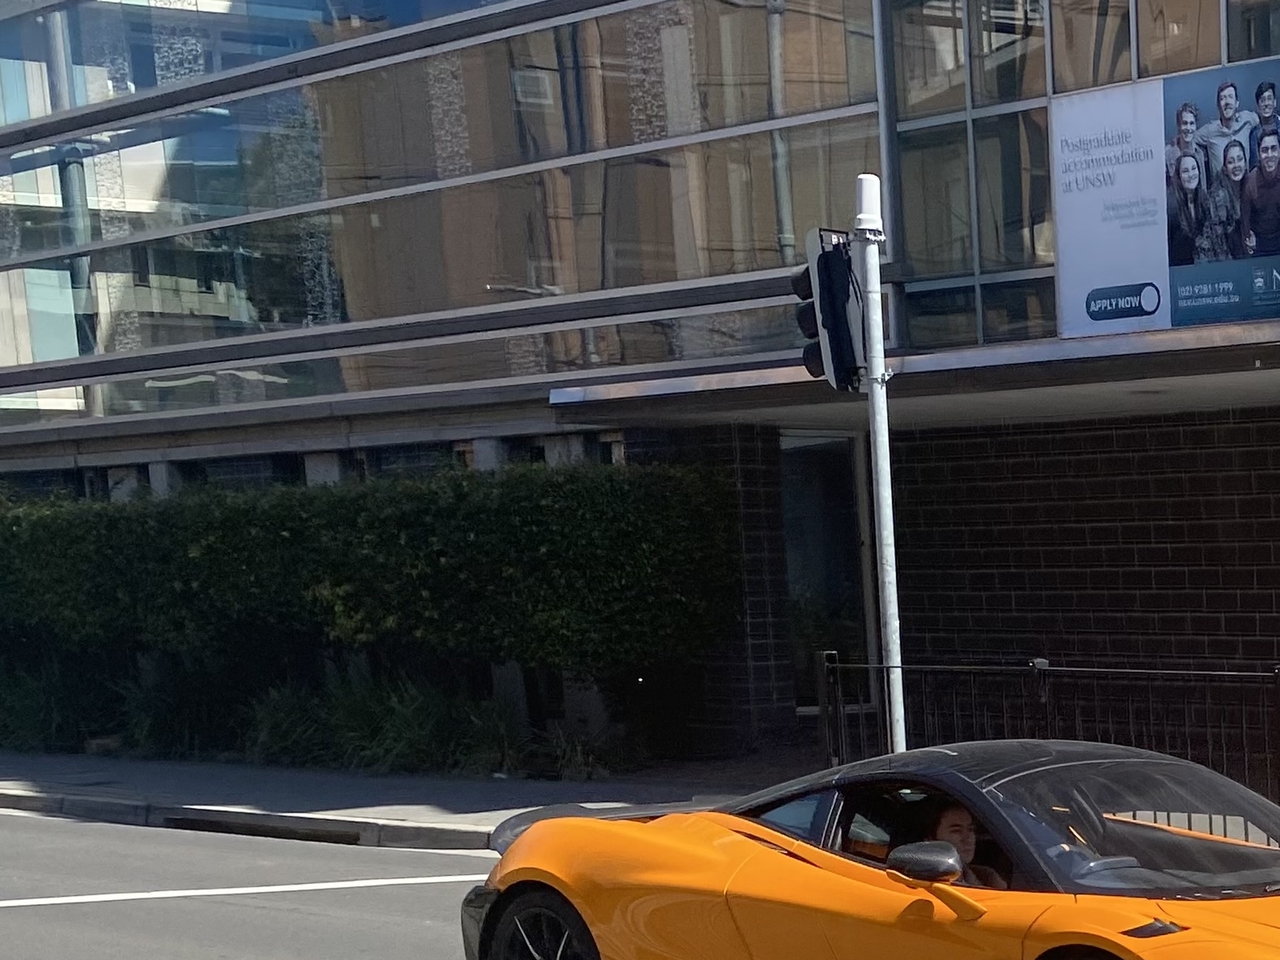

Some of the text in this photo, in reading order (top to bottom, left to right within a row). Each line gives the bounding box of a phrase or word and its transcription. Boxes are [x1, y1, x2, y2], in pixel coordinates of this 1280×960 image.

[1060, 128, 1132, 155] Postgraduate
[1062, 147, 1154, 174] accommodation
[1062, 172, 1116, 193] at UNSW
[1090, 293, 1141, 312] APPLY NOW
